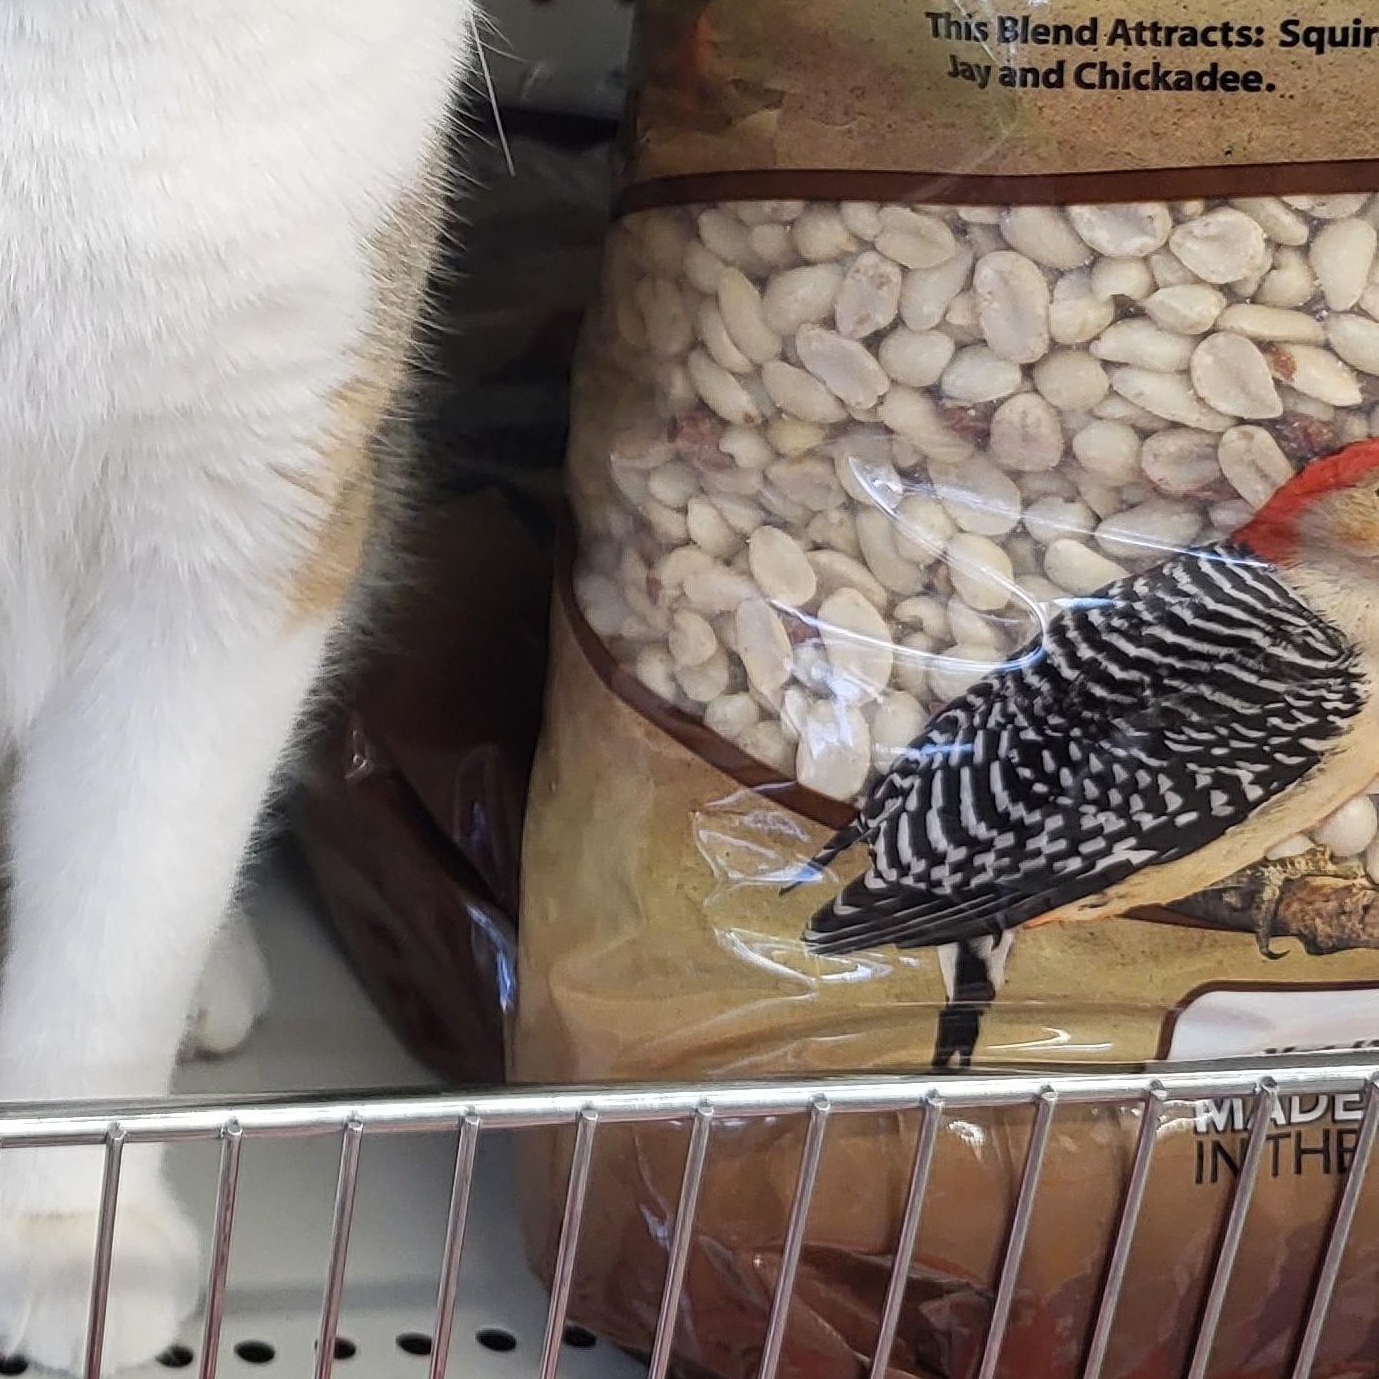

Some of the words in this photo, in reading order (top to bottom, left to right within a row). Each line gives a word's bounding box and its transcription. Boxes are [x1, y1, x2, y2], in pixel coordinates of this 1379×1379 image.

[925, 11, 988, 43] This
[997, 14, 1098, 46] Blend
[1106, 18, 1265, 48] Attracts:
[947, 53, 992, 89] Jay
[998, 59, 1066, 88] and
[1073, 61, 1277, 92] Chickadee.
